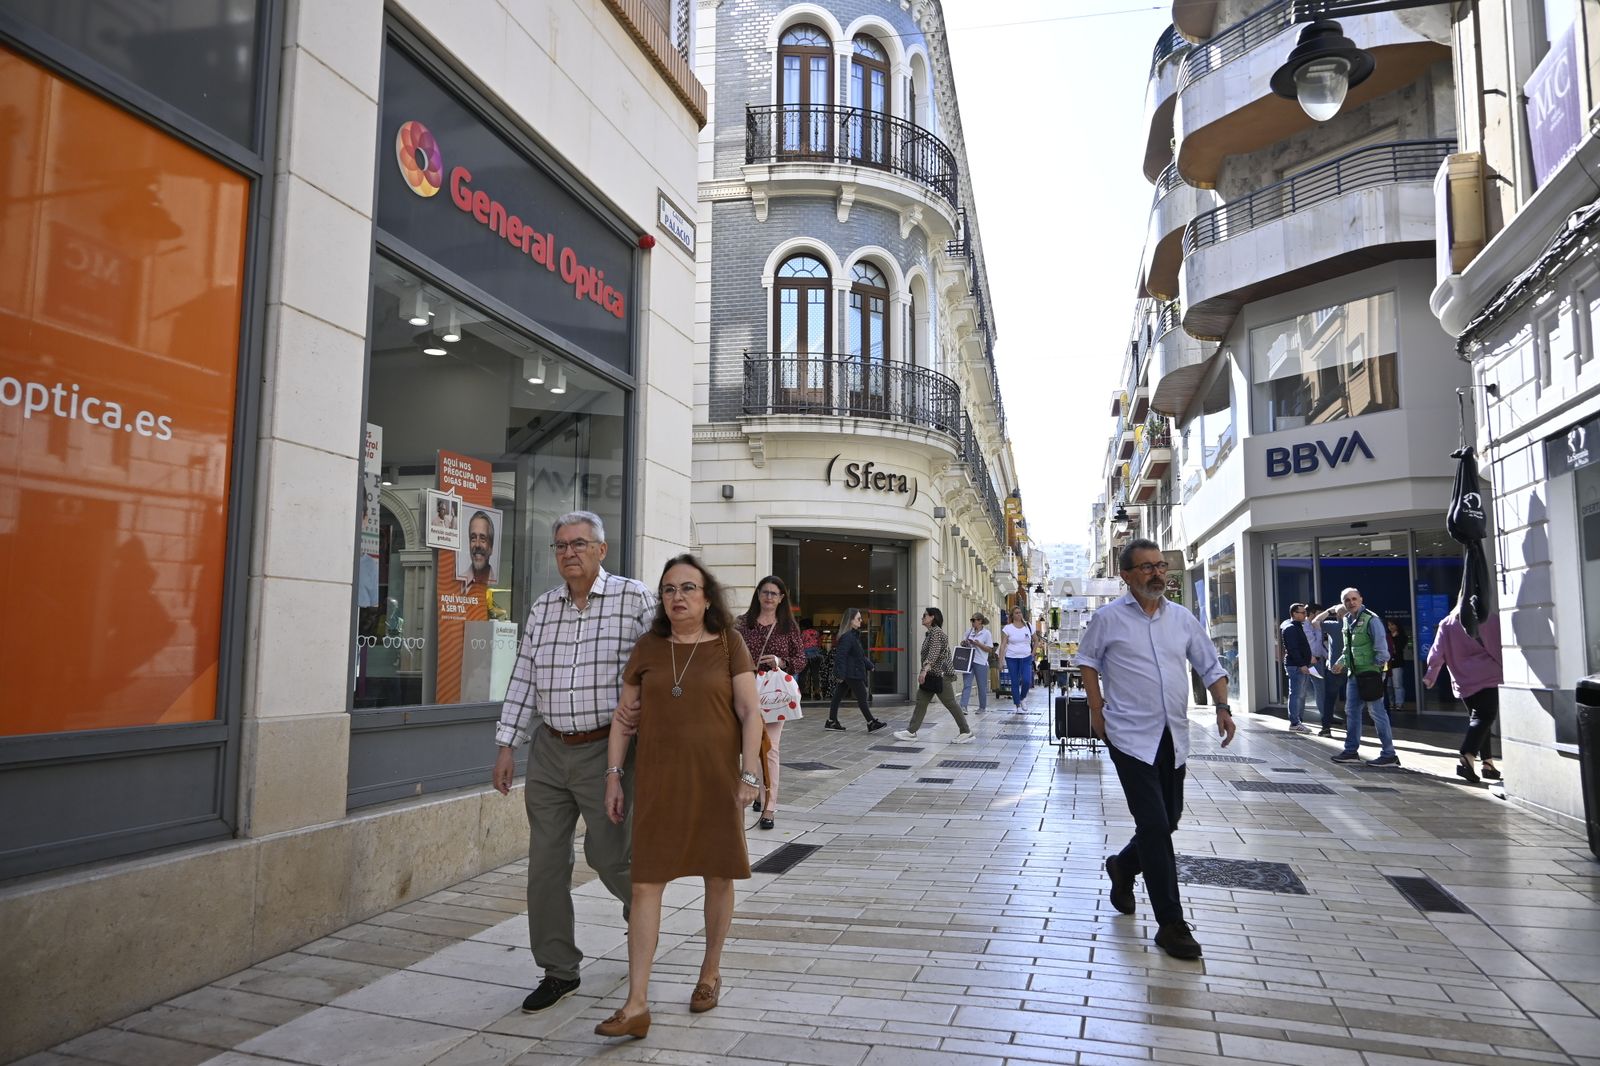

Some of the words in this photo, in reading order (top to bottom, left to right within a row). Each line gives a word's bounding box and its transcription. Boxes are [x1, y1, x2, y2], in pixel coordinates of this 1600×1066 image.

[1535, 56, 1570, 129] MC
[449, 165, 555, 273] General
[560, 247, 625, 318] Optica
[665, 214, 690, 246] PALACIO
[0, 376, 174, 441] optica.es
[443, 457, 458, 468] AQUÍ
[460, 462, 472, 471] NOS
[1266, 430, 1374, 479] BBVA
[443, 466, 474, 481] PREOCUPA
[475, 474, 488, 484] QUE
[443, 475, 462, 486] OIGAS
[463, 480, 478, 491] BIEN.
[441, 593, 455, 603] AQUÍ
[456, 595, 479, 605] VUELVES
